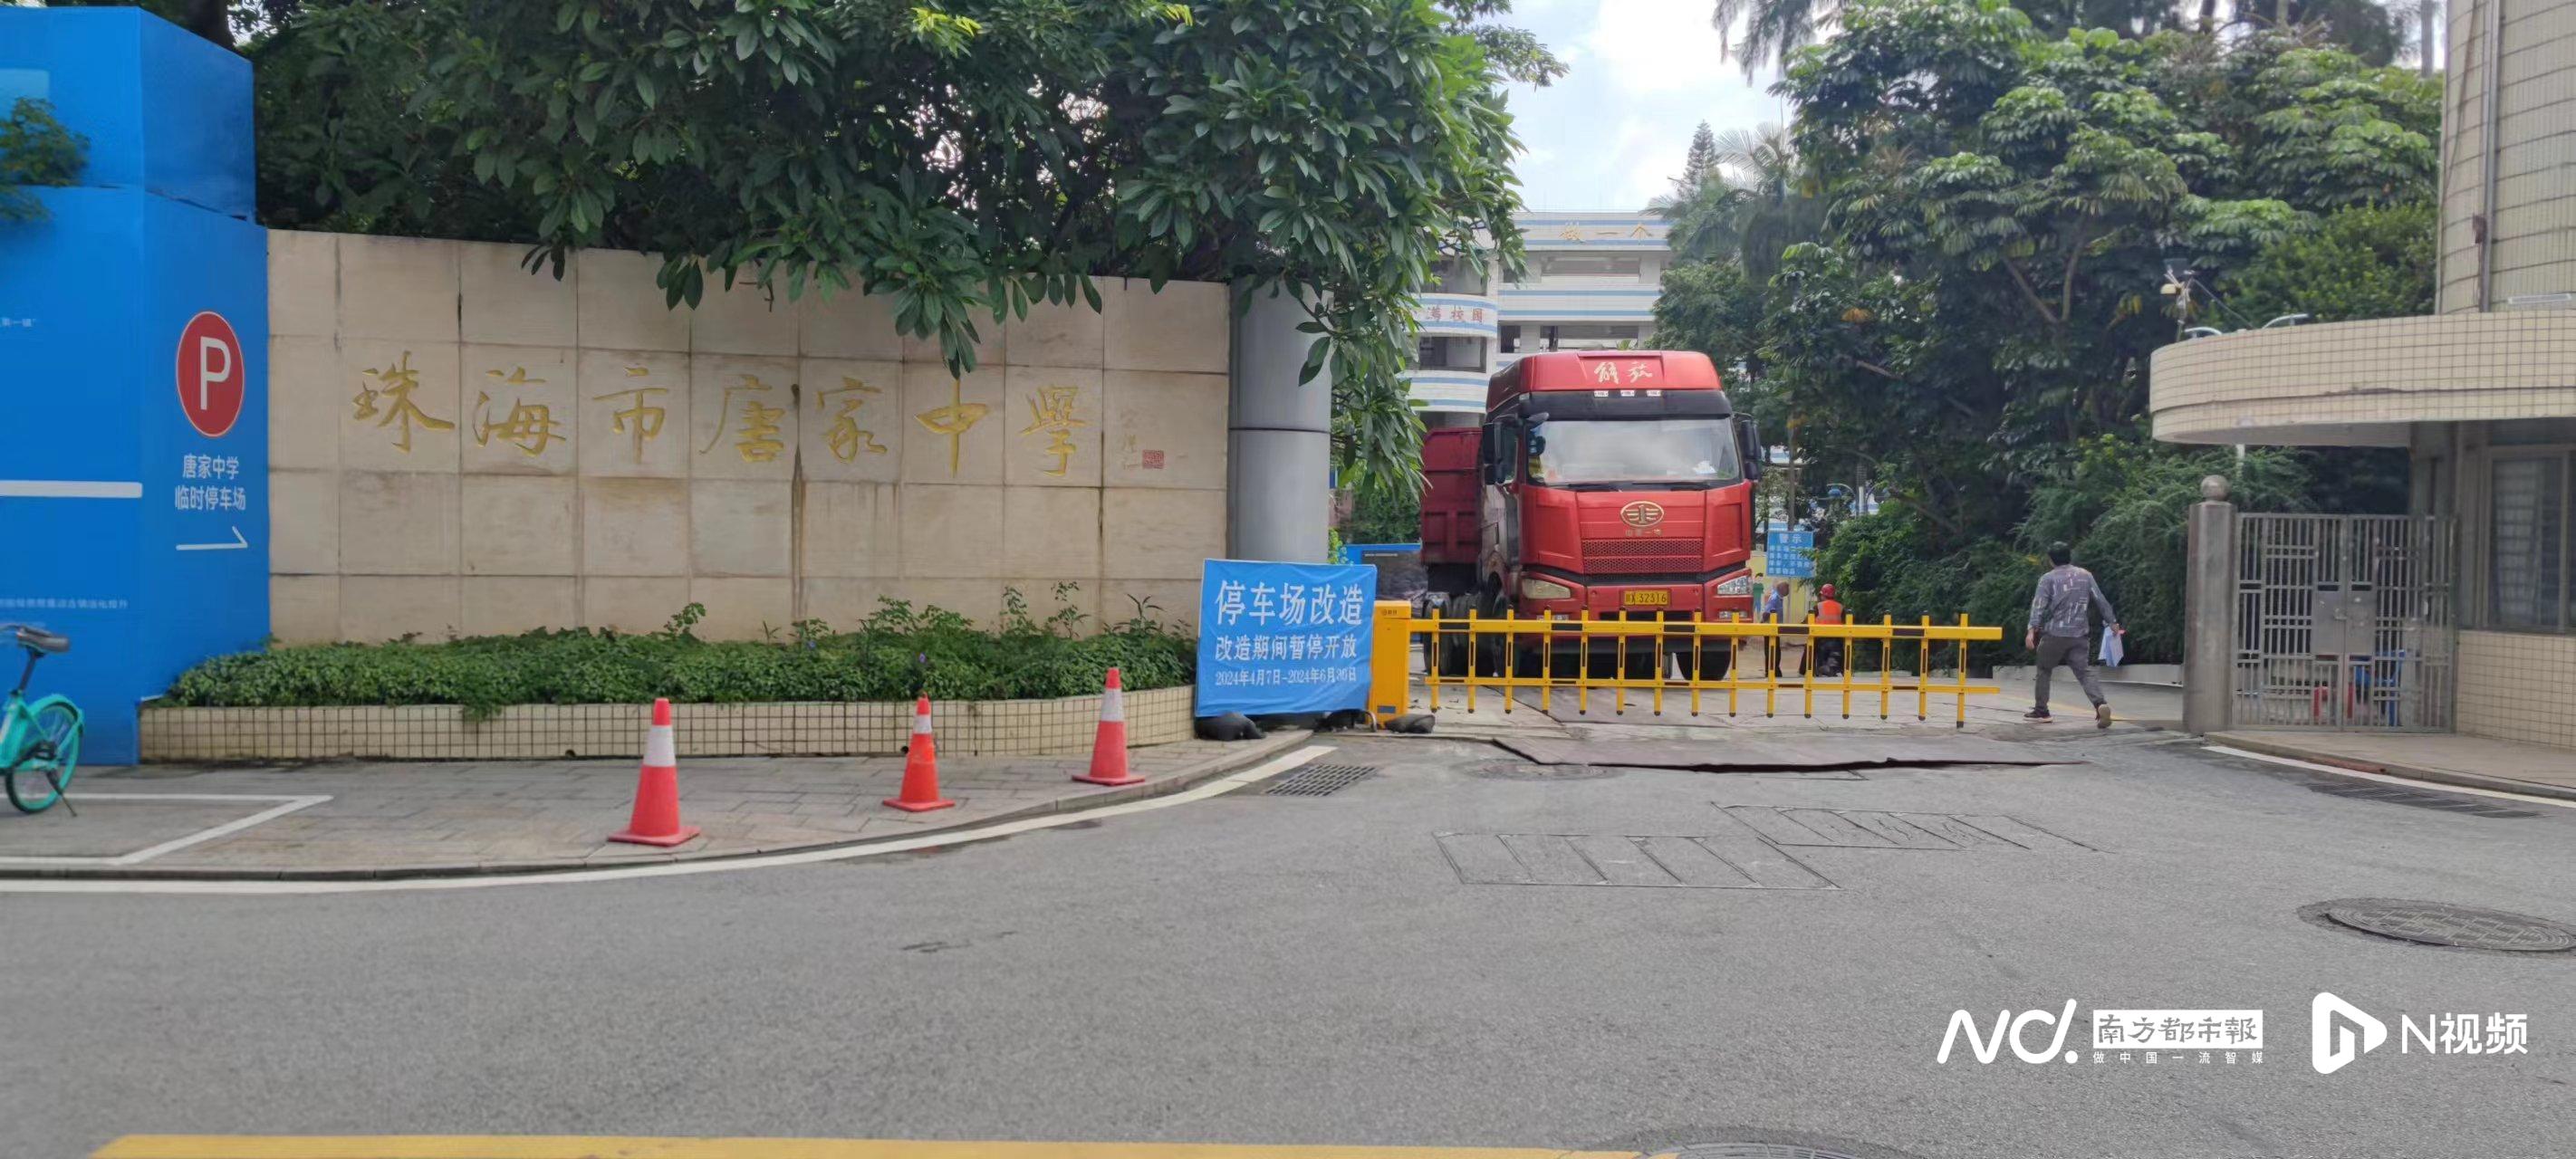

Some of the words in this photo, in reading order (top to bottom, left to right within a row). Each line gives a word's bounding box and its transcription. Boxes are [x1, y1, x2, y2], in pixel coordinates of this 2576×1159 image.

[200, 336, 231, 410] P
[182, 455, 239, 480] 唐家中学
[175, 486, 246, 510] 临时停车场
[1215, 580, 1364, 626] 停车场改造
[1215, 635, 1357, 661] 改造期间暂停开放
